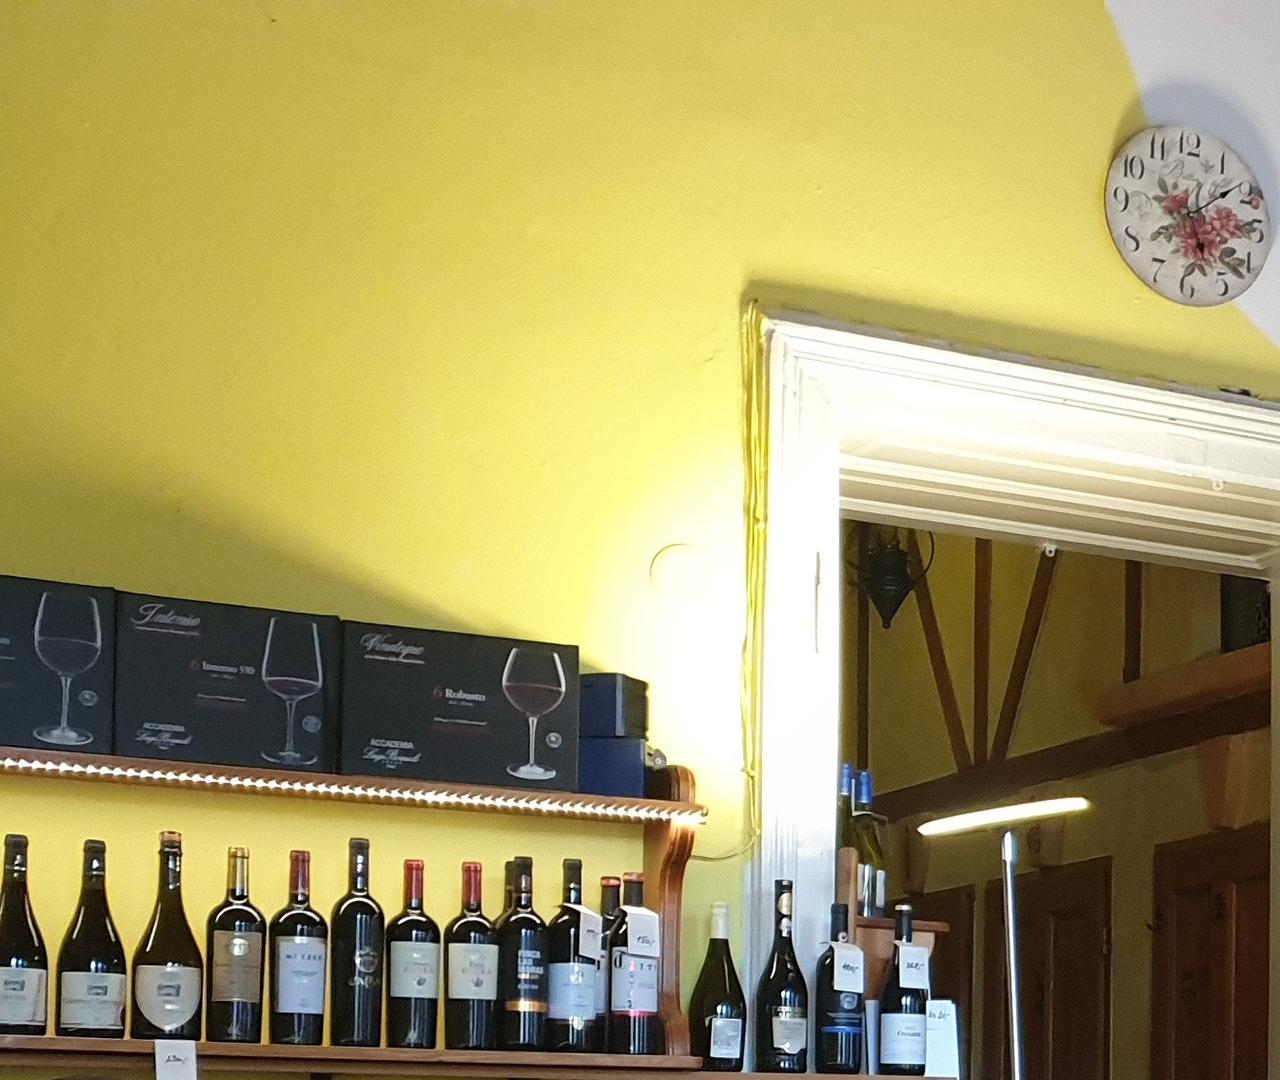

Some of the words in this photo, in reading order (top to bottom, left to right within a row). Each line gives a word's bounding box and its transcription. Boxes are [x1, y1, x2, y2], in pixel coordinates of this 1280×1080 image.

[1150, 133, 1166, 160] 11
[1179, 131, 1202, 158] 12
[1123, 154, 1145, 180] 10
[1219, 151, 1226, 174] 1
[1113, 185, 1130, 212] 9
[1151, 257, 1167, 283] 7
[1179, 268, 1195, 298] 6
[1215, 271, 1230, 296] 5
[445, 687, 487, 702] Robusto
